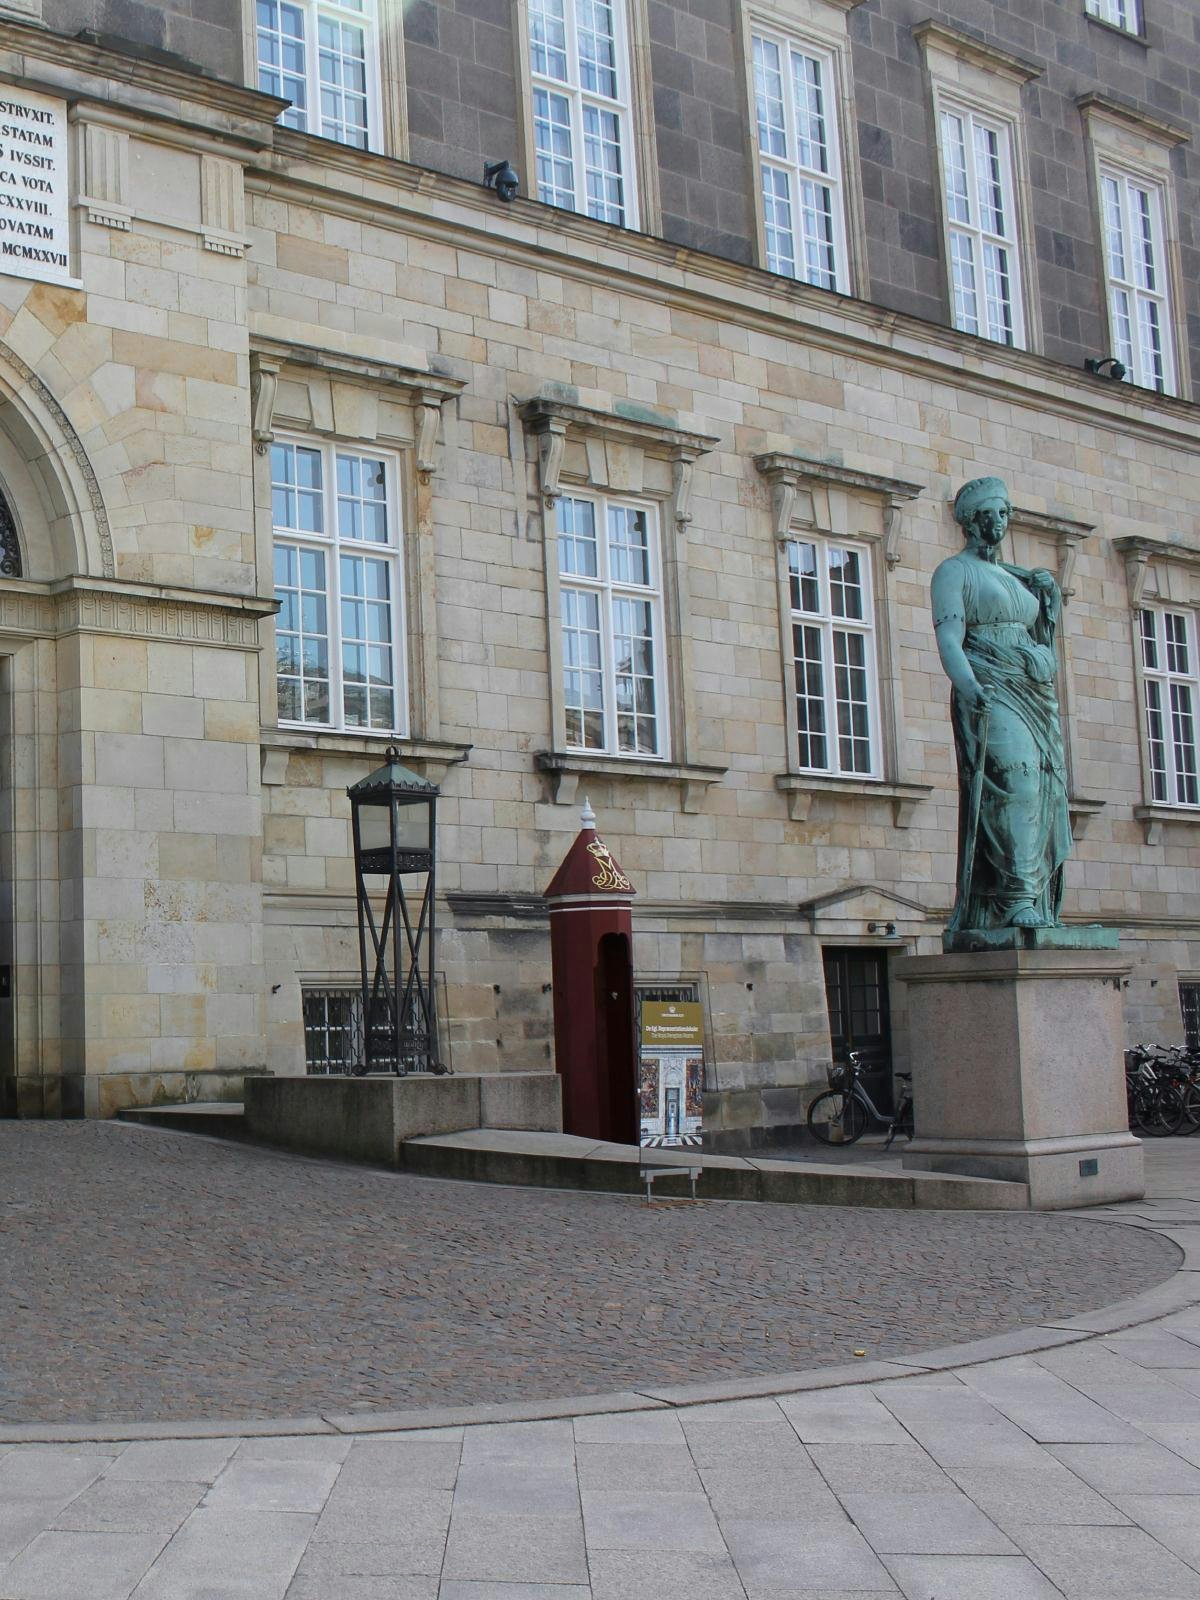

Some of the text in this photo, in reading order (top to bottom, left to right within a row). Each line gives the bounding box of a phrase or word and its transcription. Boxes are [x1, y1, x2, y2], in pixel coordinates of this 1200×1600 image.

[10, 150, 56, 171] IVSSIT.
[21, 175, 54, 194] VOTA
[2, 242, 67, 267] MCMXXVII
